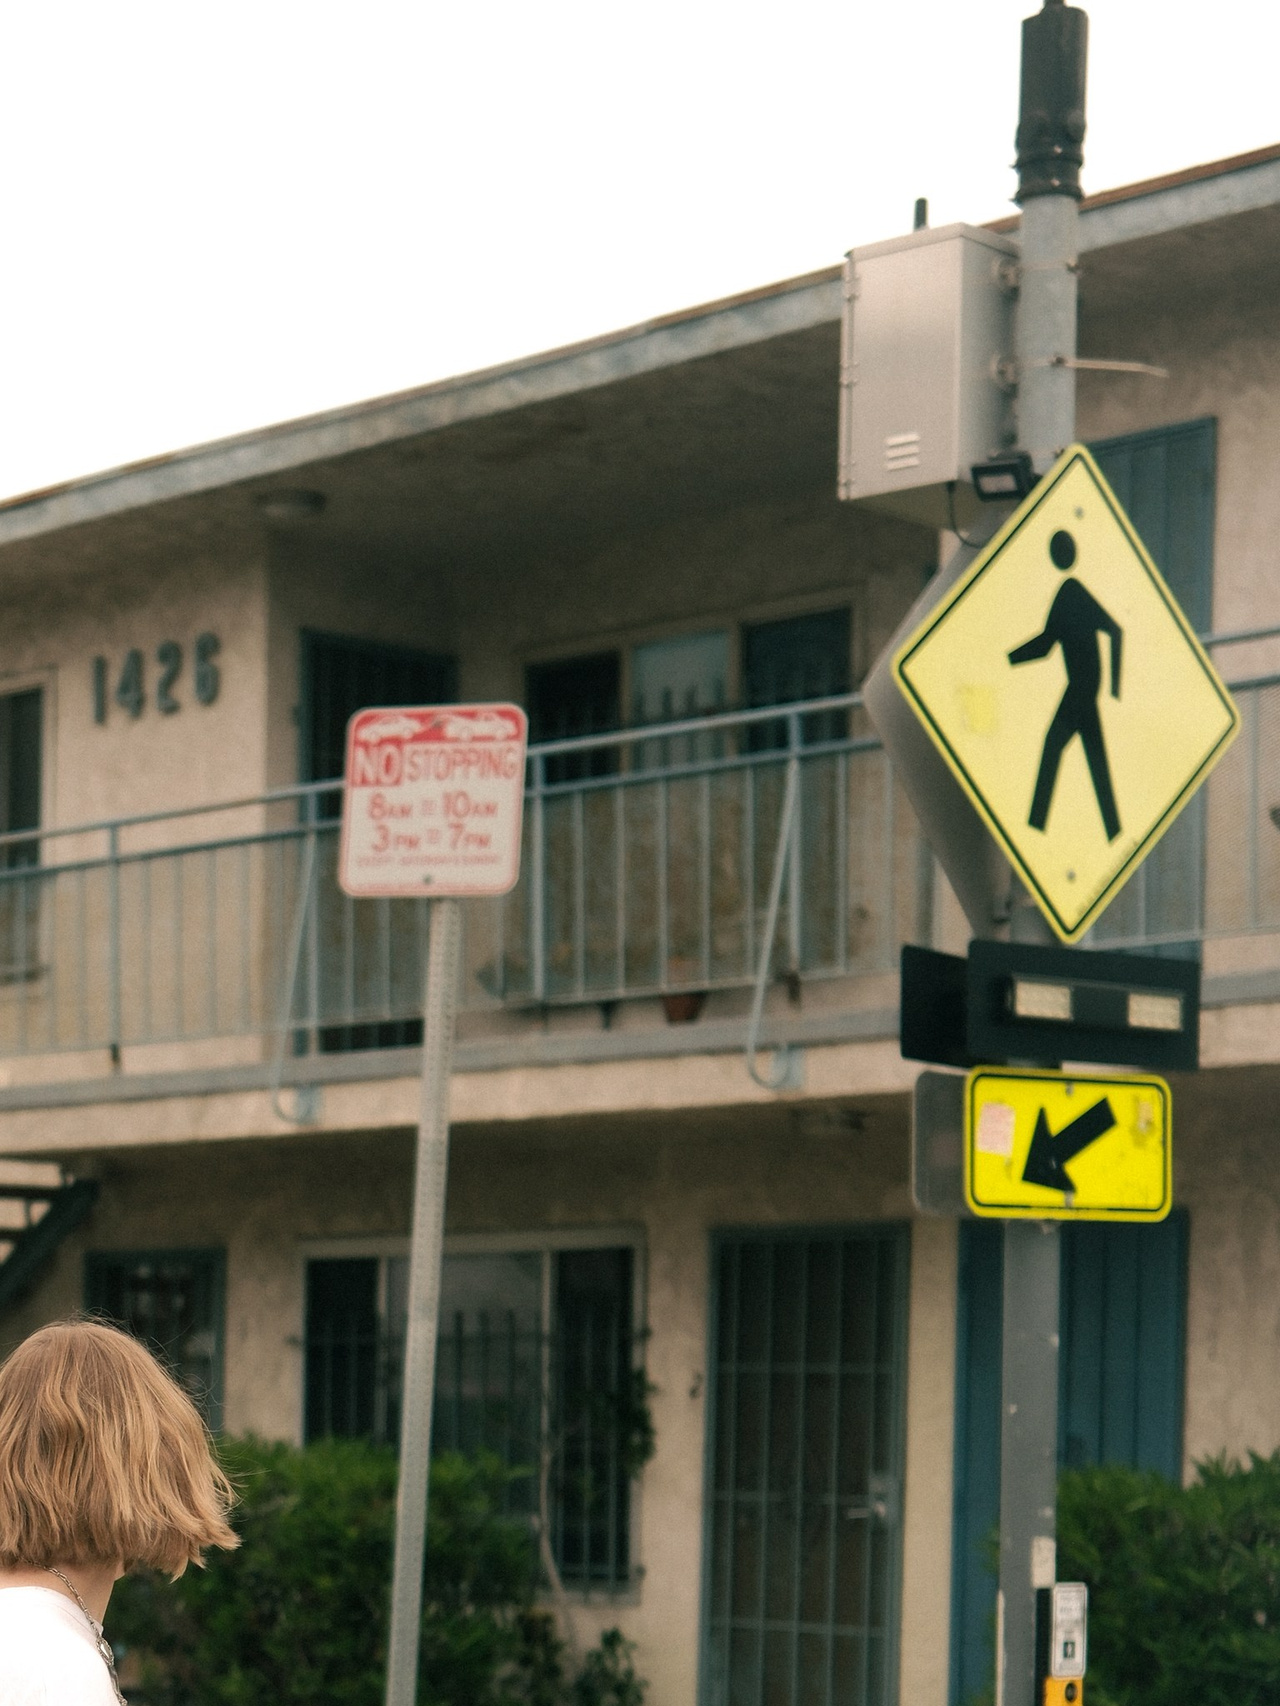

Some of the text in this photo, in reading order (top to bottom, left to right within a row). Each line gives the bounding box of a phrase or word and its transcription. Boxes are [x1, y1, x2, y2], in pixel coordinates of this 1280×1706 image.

[93, 631, 221, 726] 1426
[354, 746, 518, 786] NO STOPPING
